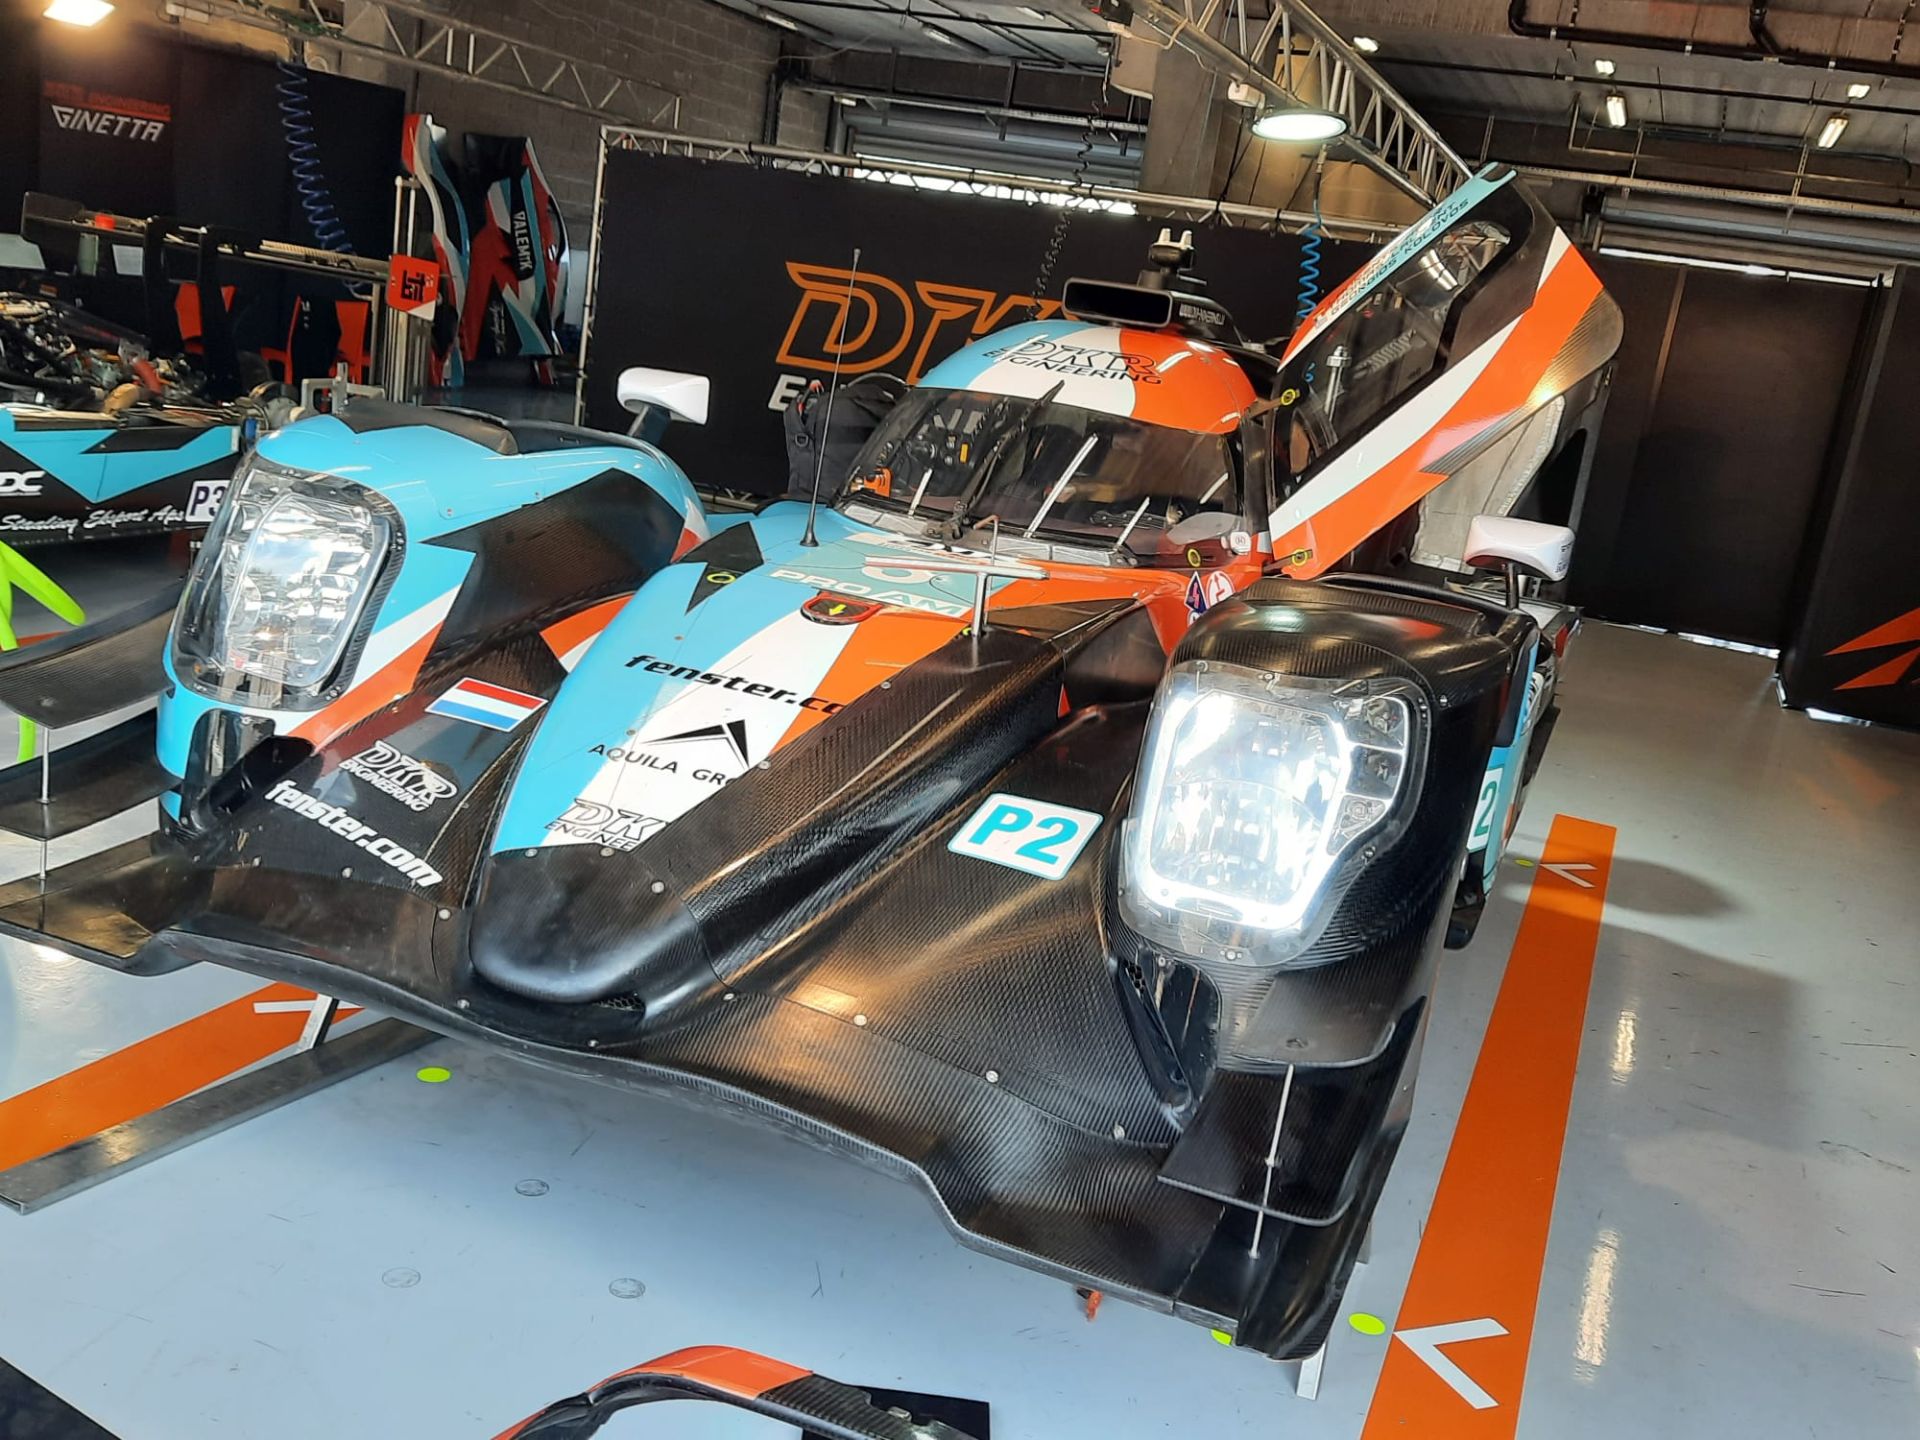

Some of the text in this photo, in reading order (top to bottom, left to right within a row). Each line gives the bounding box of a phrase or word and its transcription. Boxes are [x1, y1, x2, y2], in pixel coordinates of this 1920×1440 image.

[51, 105, 164, 141] GINETTA
[1404, 198, 1469, 255] KOLOVOS
[775, 261, 1080, 386] DK
[983, 347, 1161, 384] ENGINEERING
[1000, 338, 1158, 376] DKR
[189, 486, 226, 516] P3
[769, 569, 872, 596] PRO
[352, 740, 457, 805] DKR
[588, 744, 678, 773] AQUILA
[339, 759, 429, 811] ENGINEERING
[1474, 780, 1497, 837] 2
[265, 780, 442, 887] fenster.com
[557, 798, 668, 841] DK
[968, 804, 1079, 865] P2
